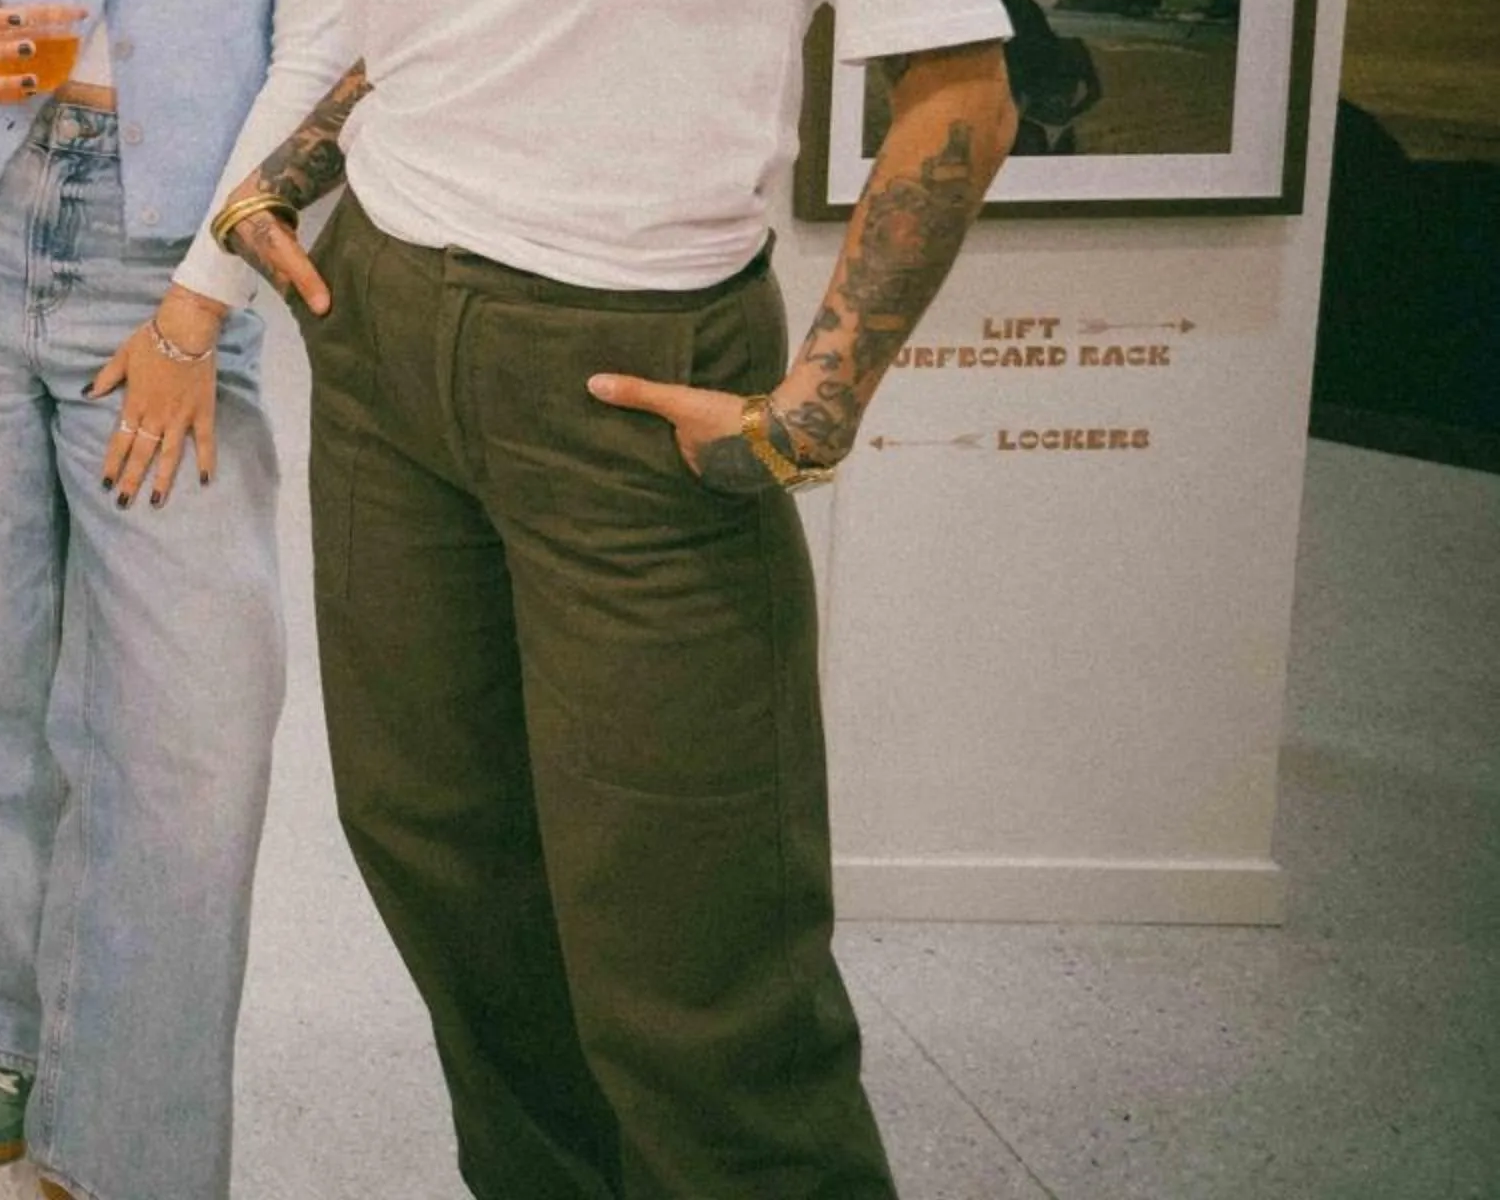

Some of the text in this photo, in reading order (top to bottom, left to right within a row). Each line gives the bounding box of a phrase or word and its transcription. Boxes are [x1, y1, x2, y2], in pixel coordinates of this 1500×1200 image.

[982, 317, 1060, 341] LIFT
[894, 344, 1170, 369] URFBOARD RACK
[997, 428, 1150, 451] LOCKERS
